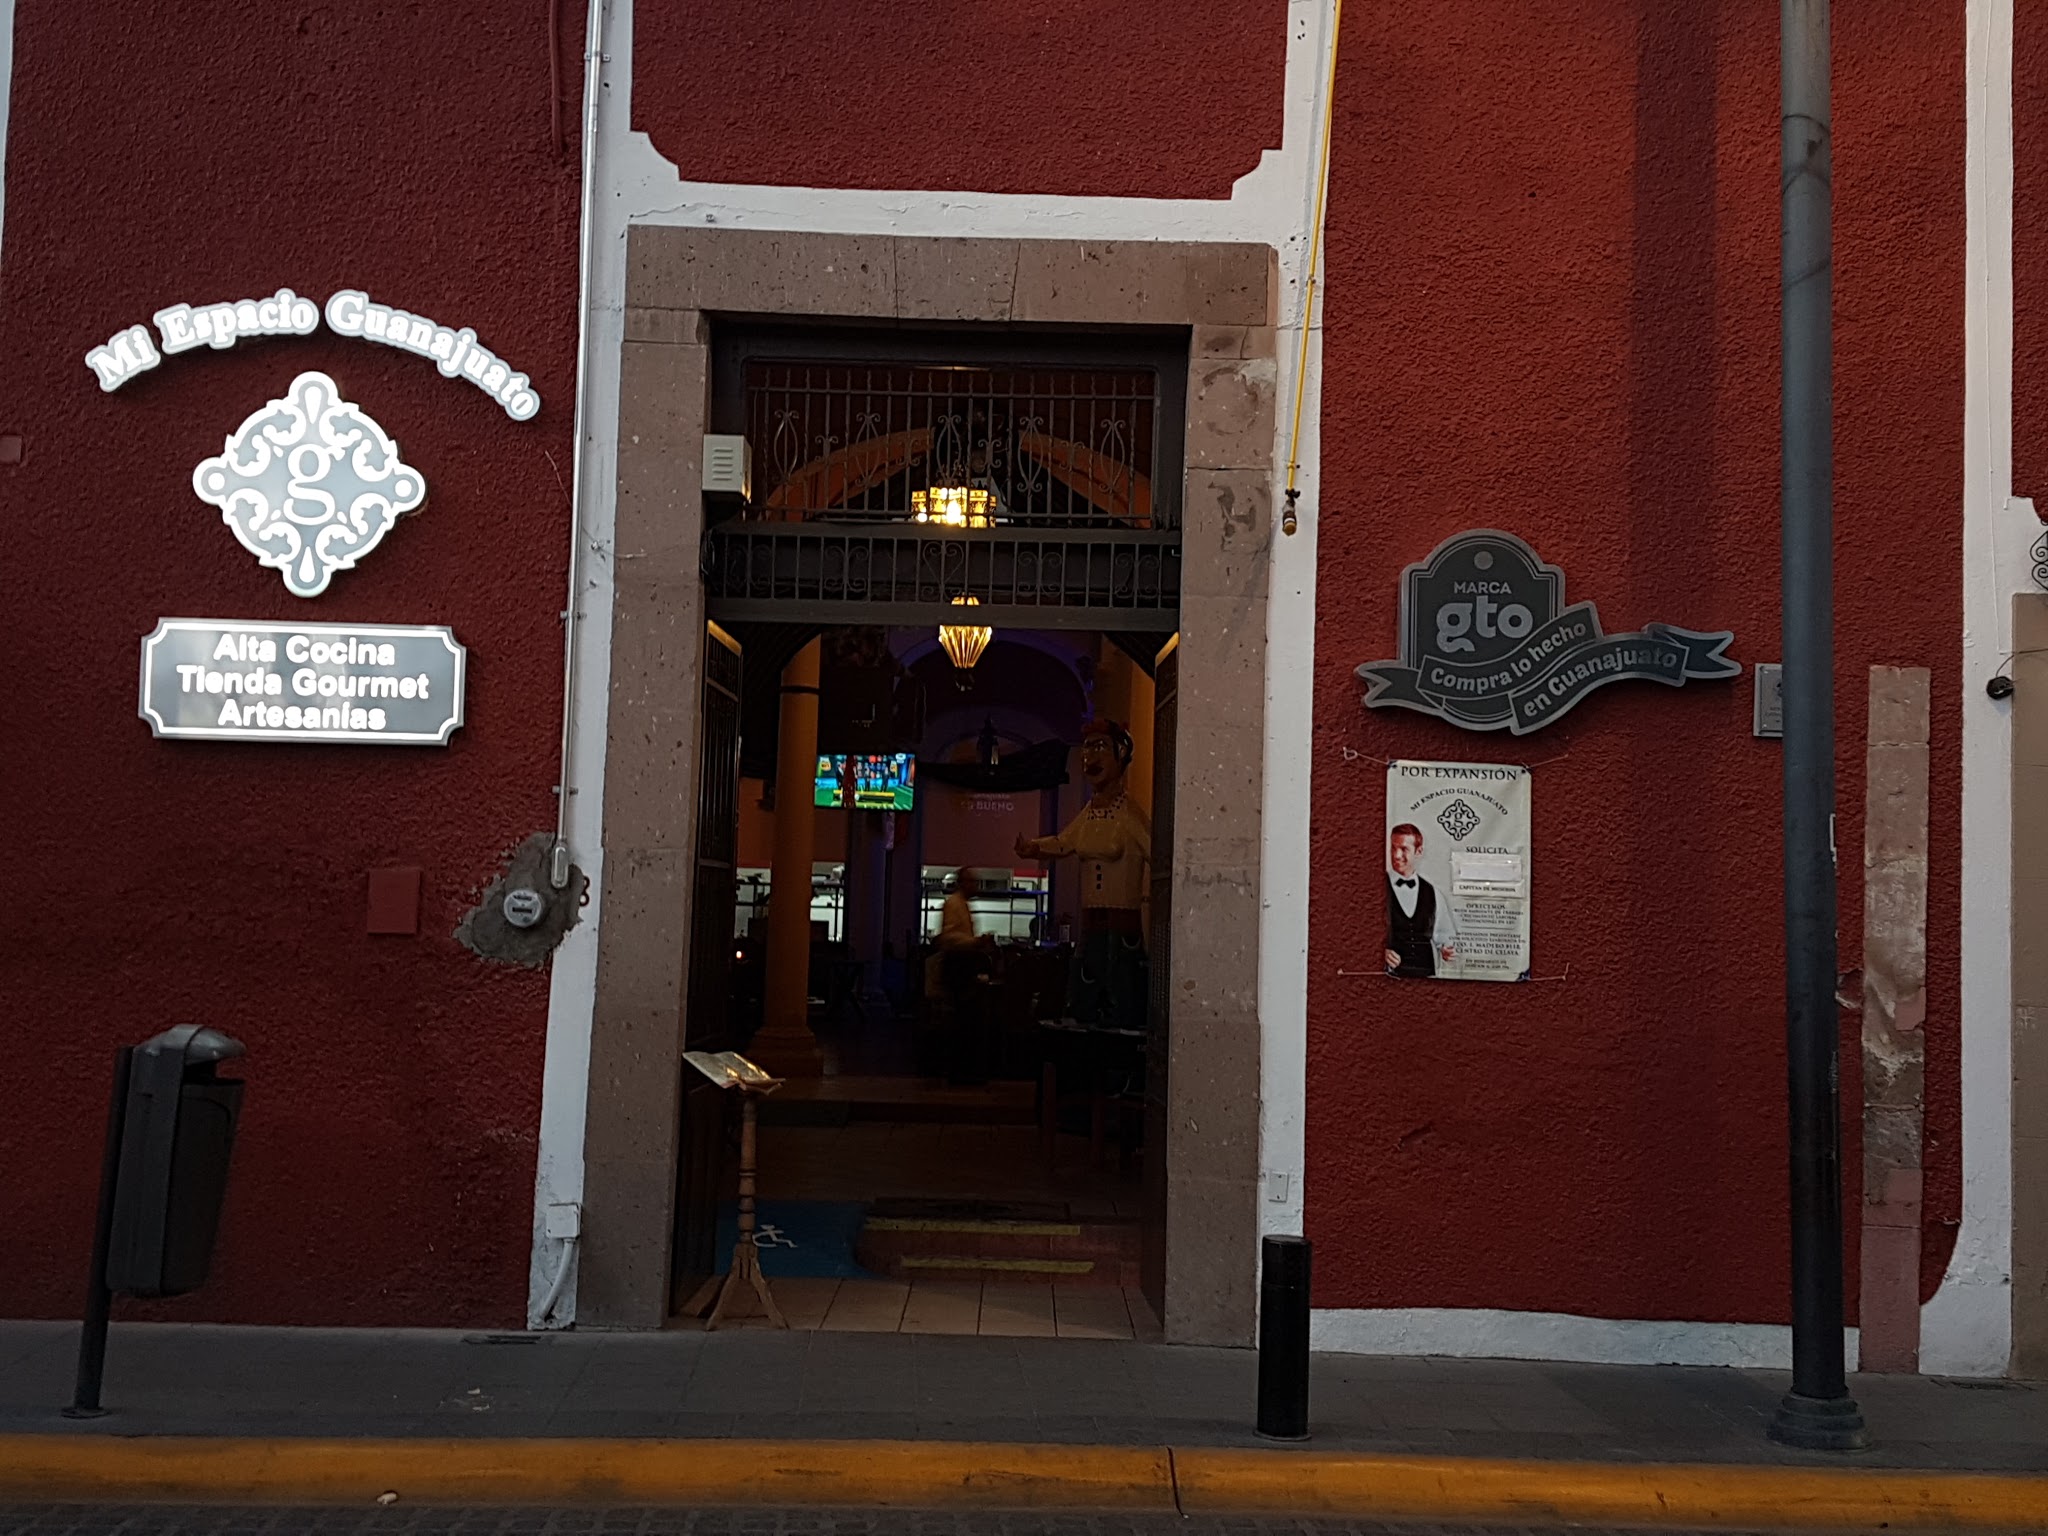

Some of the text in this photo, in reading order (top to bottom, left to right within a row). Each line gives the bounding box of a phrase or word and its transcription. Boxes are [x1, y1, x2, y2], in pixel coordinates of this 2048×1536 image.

[88, 290, 537, 418] Mi Espacio Guanajuato
[1453, 581, 1512, 594] MARCA
[1436, 595, 1533, 653] gto
[213, 633, 395, 666] Alta Cocina
[1430, 622, 1586, 695] Compra lo hecho
[176, 664, 430, 700] Tienda Gourmet
[1523, 647, 1677, 717] en Guanajuato
[1401, 766, 1517, 780] POR EXPANSIÓN
[1410, 788, 1508, 815] MI ESPACIO GUANAJUATO
[1466, 846, 1509, 854] SOLICITA
